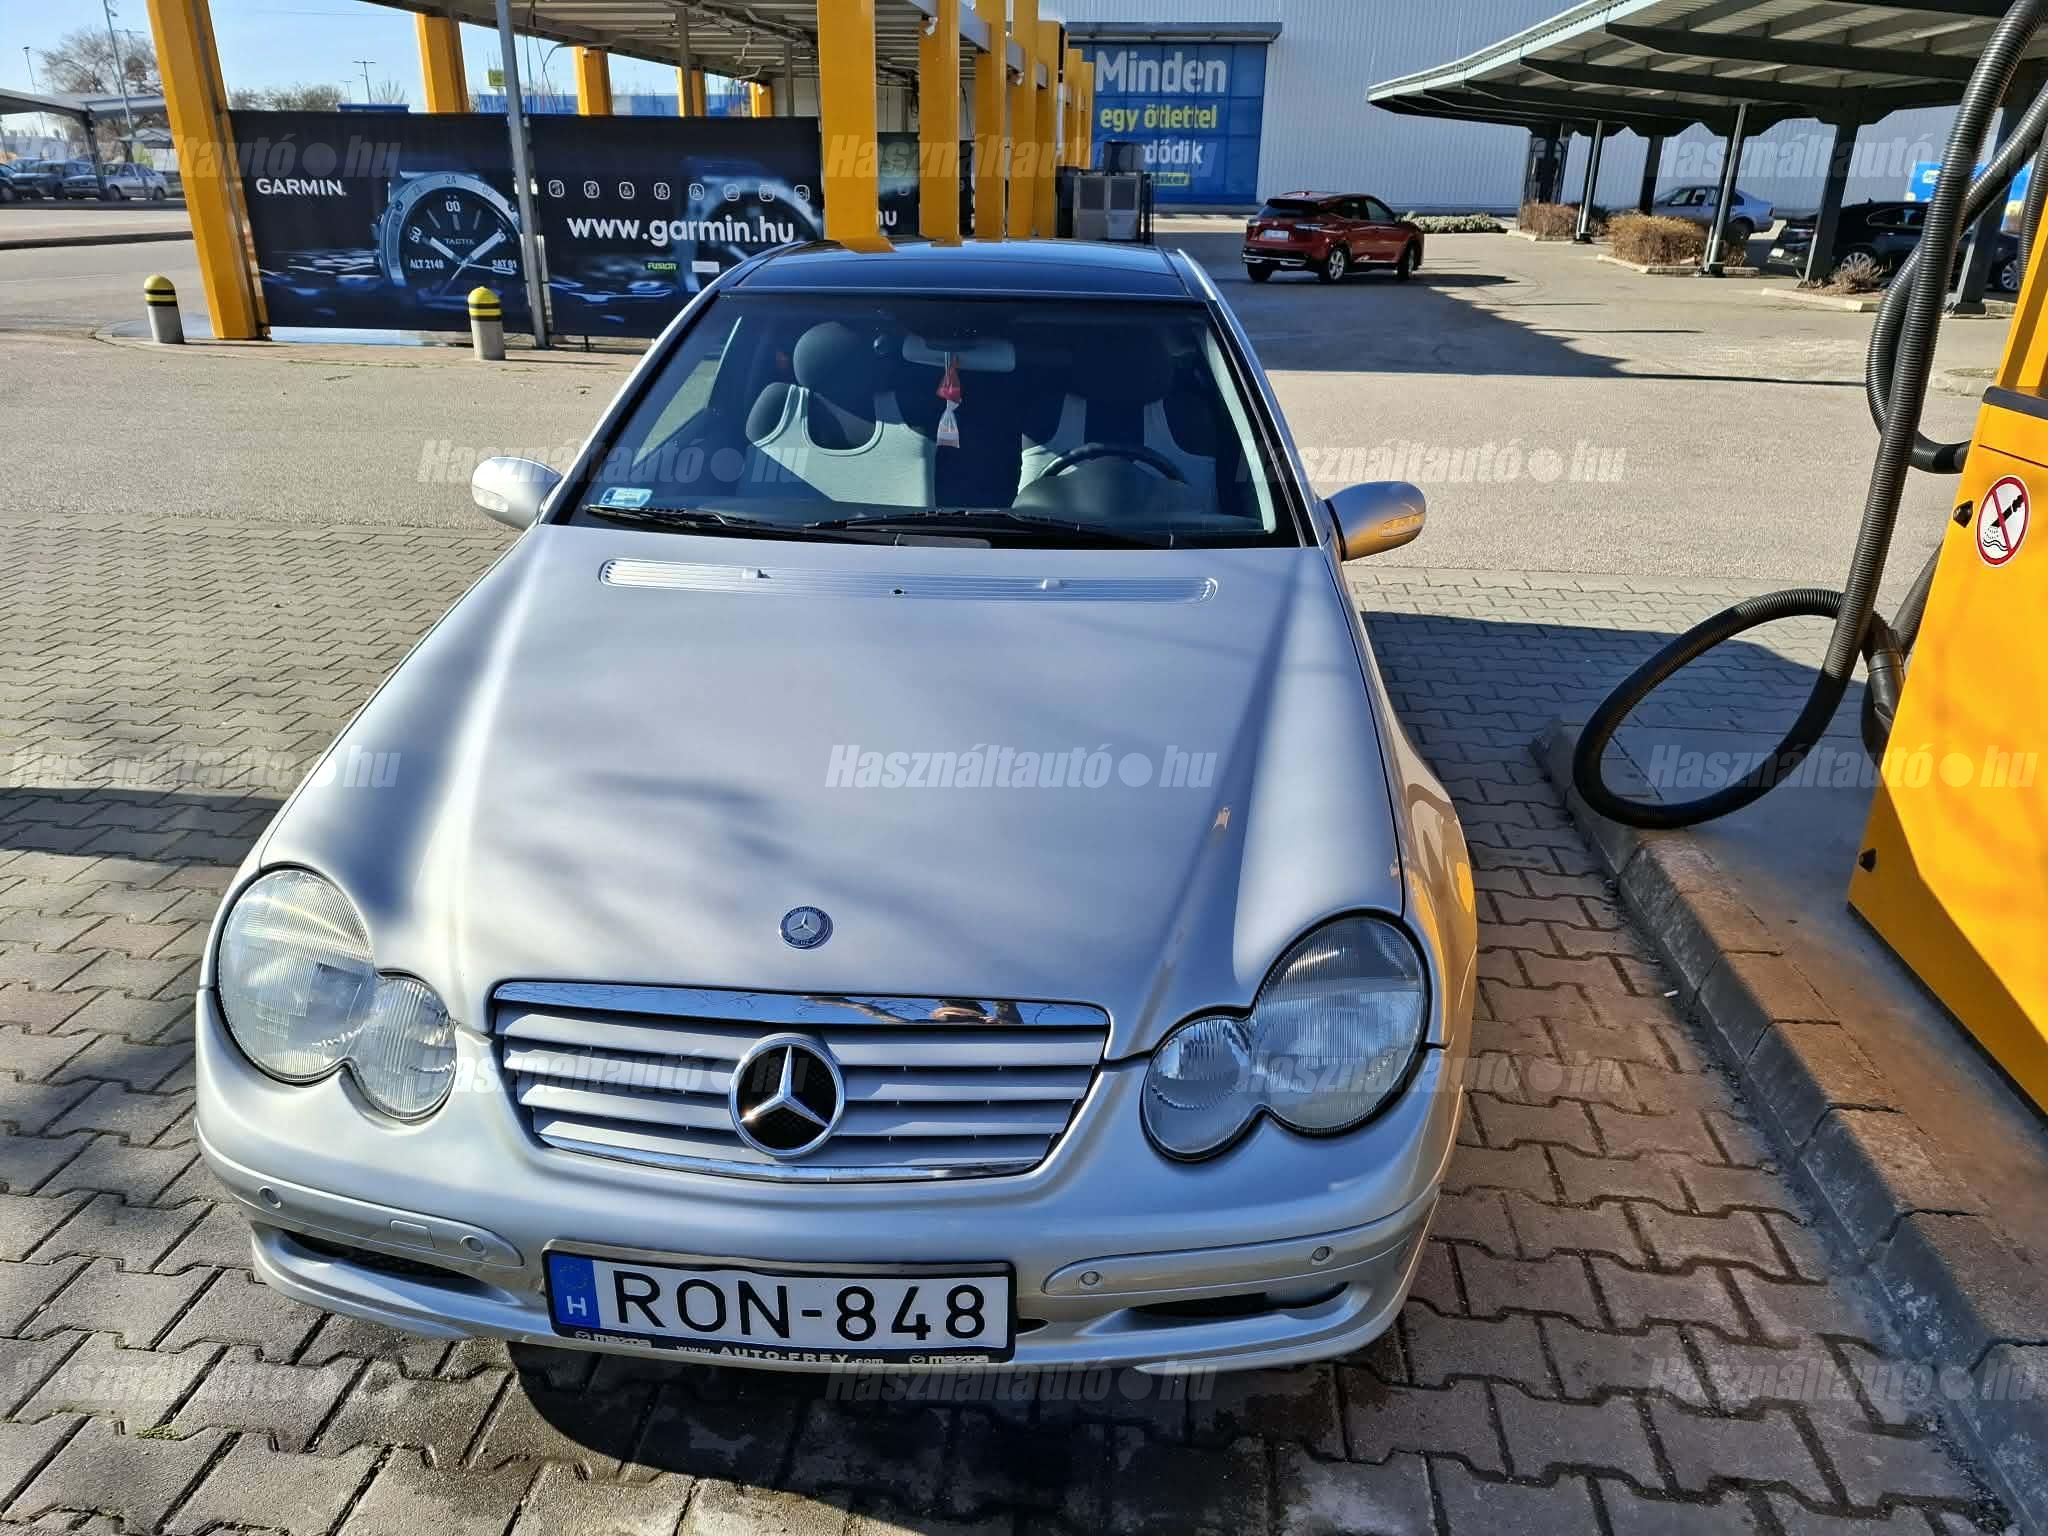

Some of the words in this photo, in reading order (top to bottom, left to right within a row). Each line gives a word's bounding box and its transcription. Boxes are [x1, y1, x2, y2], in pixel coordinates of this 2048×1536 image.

[1096, 51, 1227, 93] Minden
[1100, 108, 1139, 132] egy
[1144, 104, 1217, 129] ötlettel
[1142, 138, 1204, 165] dődik
[255, 177, 344, 196] GARMIN
[567, 214, 794, 247] www.garmin.hu
[566, 1294, 588, 1317] H
[613, 1270, 986, 1342] RON-848
